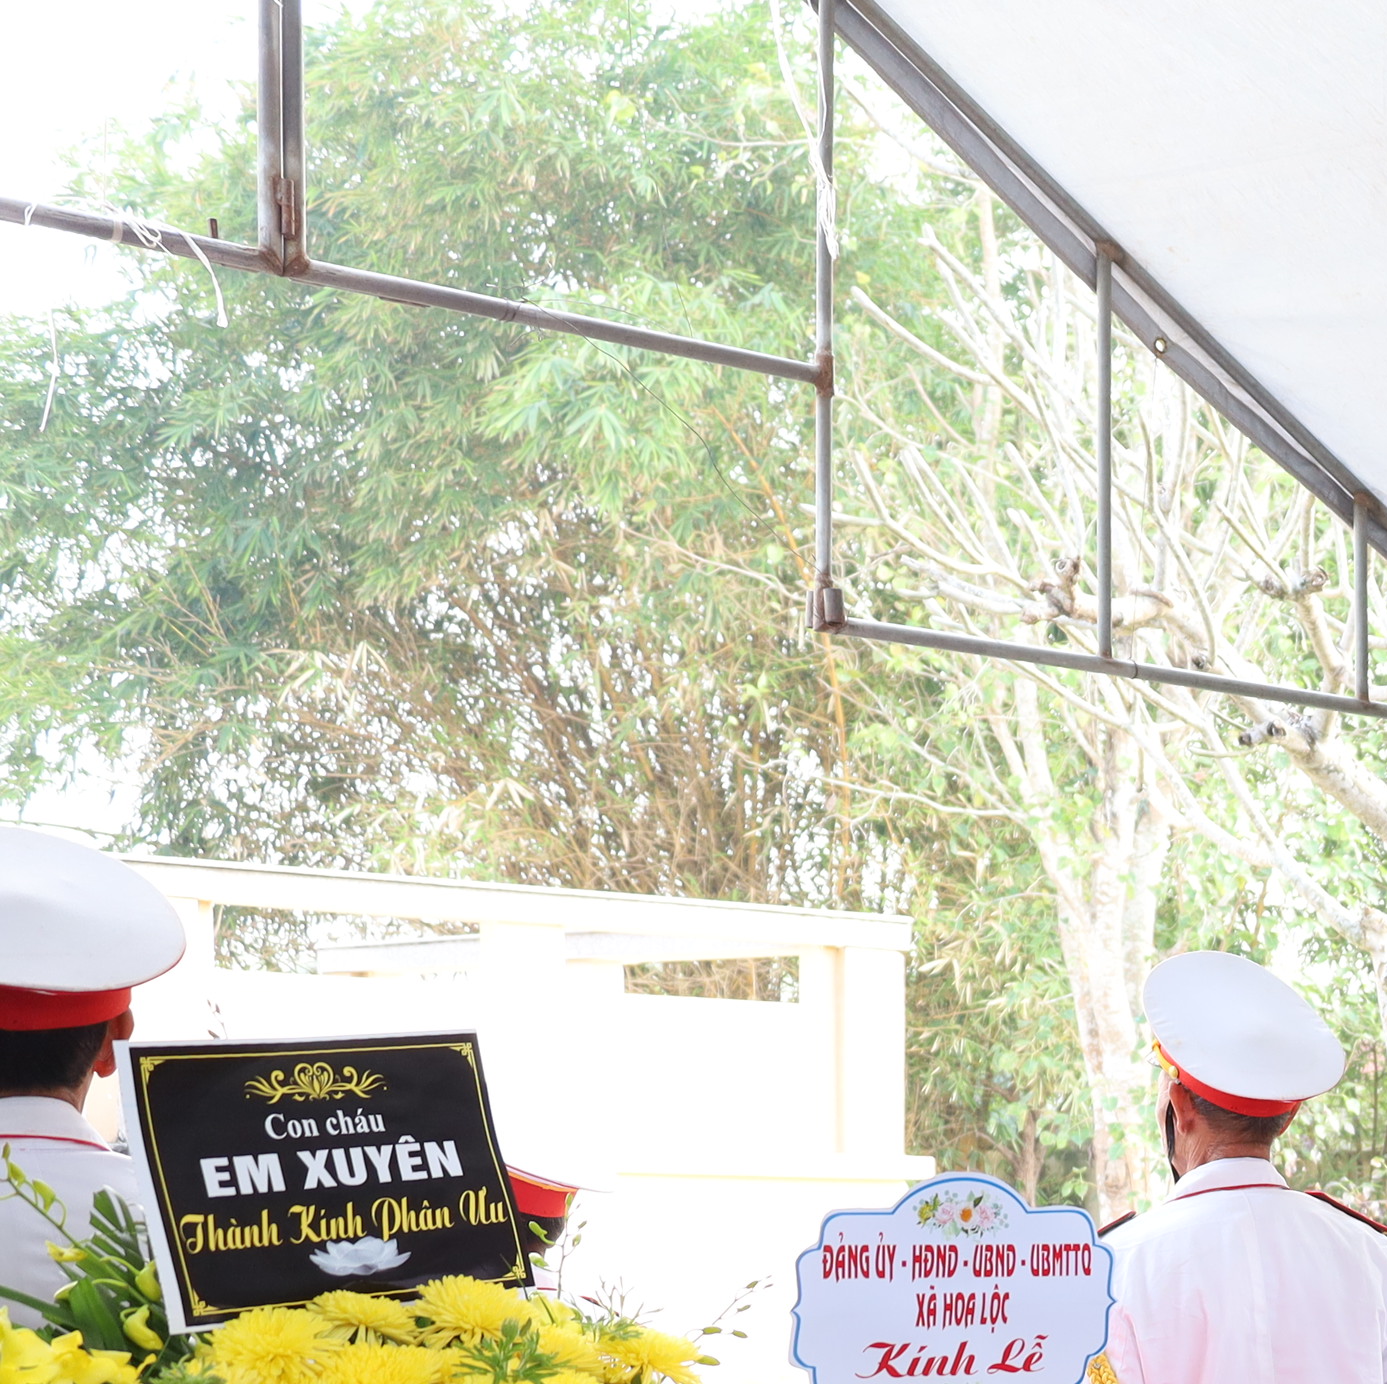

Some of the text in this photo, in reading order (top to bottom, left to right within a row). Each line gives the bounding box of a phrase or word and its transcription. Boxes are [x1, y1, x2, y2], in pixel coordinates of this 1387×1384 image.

[264, 1107, 386, 1140] Con cháu
[200, 1134, 464, 1198] EM XUYÊN
[180, 1209, 283, 1255] Thành
[288, 1200, 363, 1243] Kính
[371, 1197, 455, 1242] Phân
[822, 1232, 870, 1283] ĐẢNG
[875, 1232, 897, 1283] ỦY
[911, 1244, 959, 1282] HĐND
[972, 1244, 1016, 1278] UBND
[1030, 1243, 1092, 1276] UBMTTQ
[915, 1283, 1010, 1333] XÃ HOA LỘC
[854, 1334, 1049, 1379] Kính Lễ
